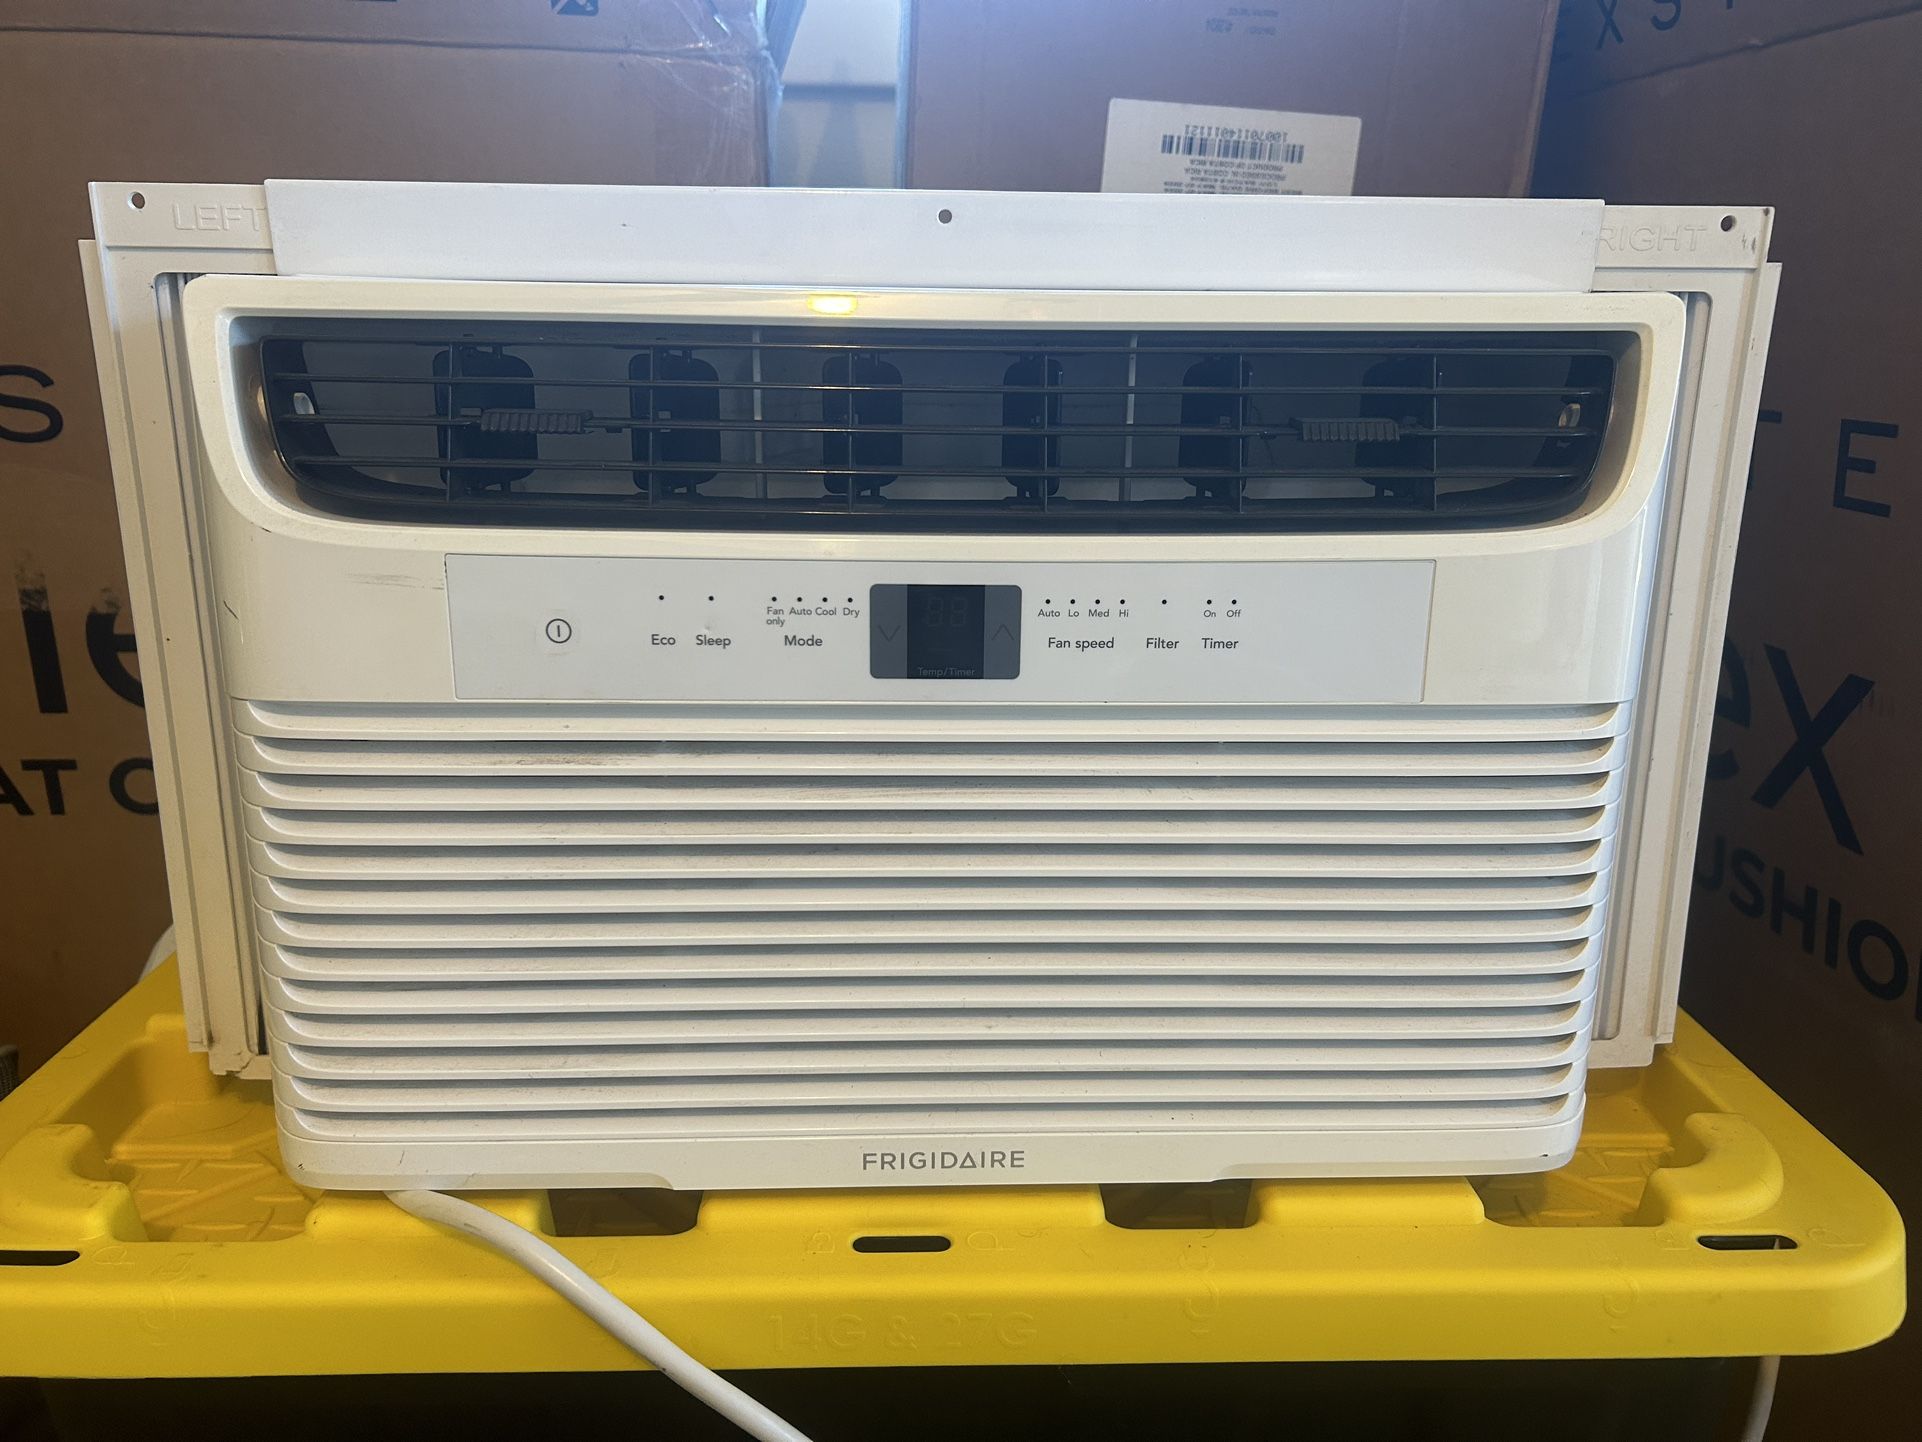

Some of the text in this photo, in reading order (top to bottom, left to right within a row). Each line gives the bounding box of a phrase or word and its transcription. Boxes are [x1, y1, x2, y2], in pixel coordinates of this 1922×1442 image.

[172, 203, 267, 231] LEFT
[1599, 224, 1707, 252] RIGHT
[766, 606, 785, 616] Fan
[789, 607, 812, 616] Auto
[815, 607, 837, 616] Cool
[843, 607, 860, 618] Dry
[1038, 609, 1061, 618] Auto
[1068, 609, 1079, 618] Lo
[1088, 609, 1110, 618] Med
[1118, 609, 1129, 618] Hi
[1203, 609, 1216, 618] On
[1226, 609, 1241, 618] Off
[766, 617, 786, 628] only
[651, 633, 676, 646] Eco
[696, 634, 731, 648] Sleep
[784, 634, 823, 647] Mode
[1048, 637, 1114, 652] Fan speed
[1146, 637, 1179, 650] Filter
[1201, 637, 1239, 650] Timer
[918, 666, 976, 679] Temp/Timer
[862, 1150, 1025, 1171] FRIGIDAIRE
[768, 1311, 1038, 1351] 14G & 27G
